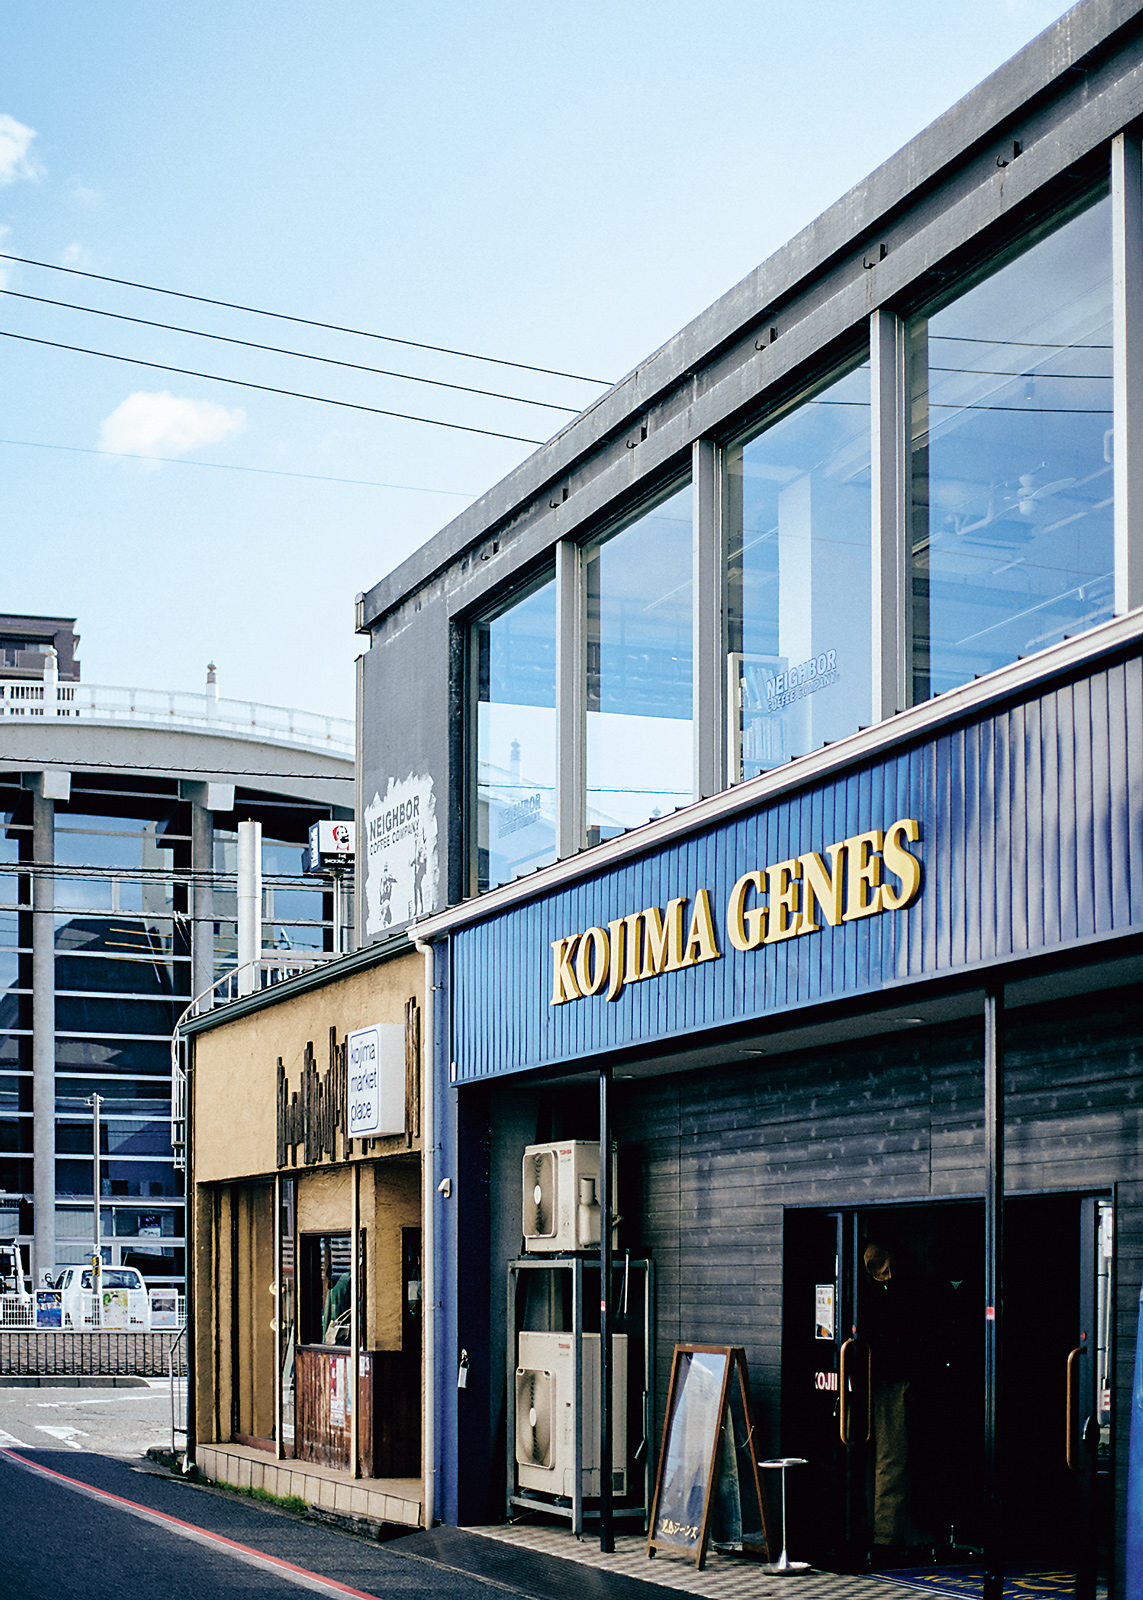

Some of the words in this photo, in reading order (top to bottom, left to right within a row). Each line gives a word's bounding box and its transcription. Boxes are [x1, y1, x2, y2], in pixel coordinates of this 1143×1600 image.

[766, 648, 838, 701] NEIGHBOR
[767, 688, 796, 714] COFFEE
[370, 795, 420, 841] NEIGHBOR
[369, 835, 391, 856] COFFEE
[391, 819, 420, 844] COMPANY
[550, 888, 721, 1006] KOJIMA
[727, 818, 921, 951] GENES
[350, 1041, 376, 1069] kojima
[350, 1068, 377, 1093] market
[350, 1099, 372, 1125] place
